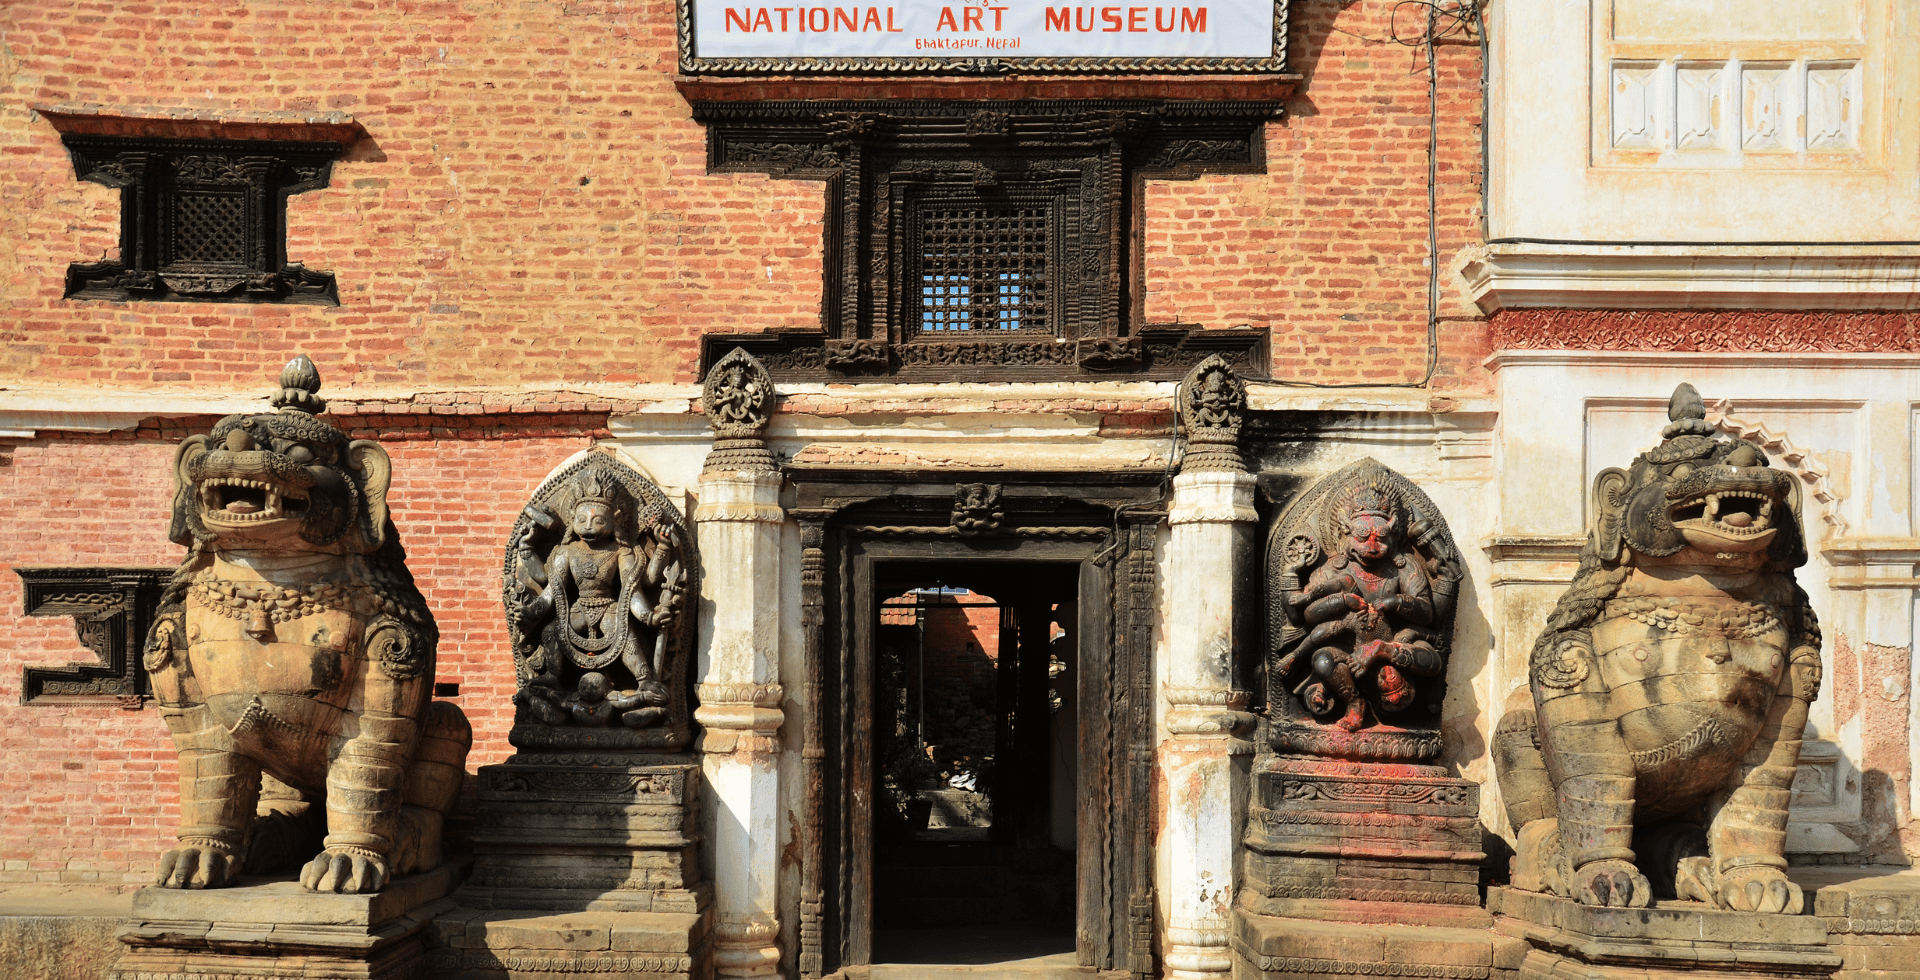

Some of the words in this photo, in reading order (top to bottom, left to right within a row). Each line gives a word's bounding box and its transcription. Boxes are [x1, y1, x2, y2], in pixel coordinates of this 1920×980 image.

[724, 8, 904, 33] NATIONAL
[936, 6, 1009, 32] ART
[1045, 6, 1208, 32] MUSEUM
[986, 37, 1021, 49] Nepal
